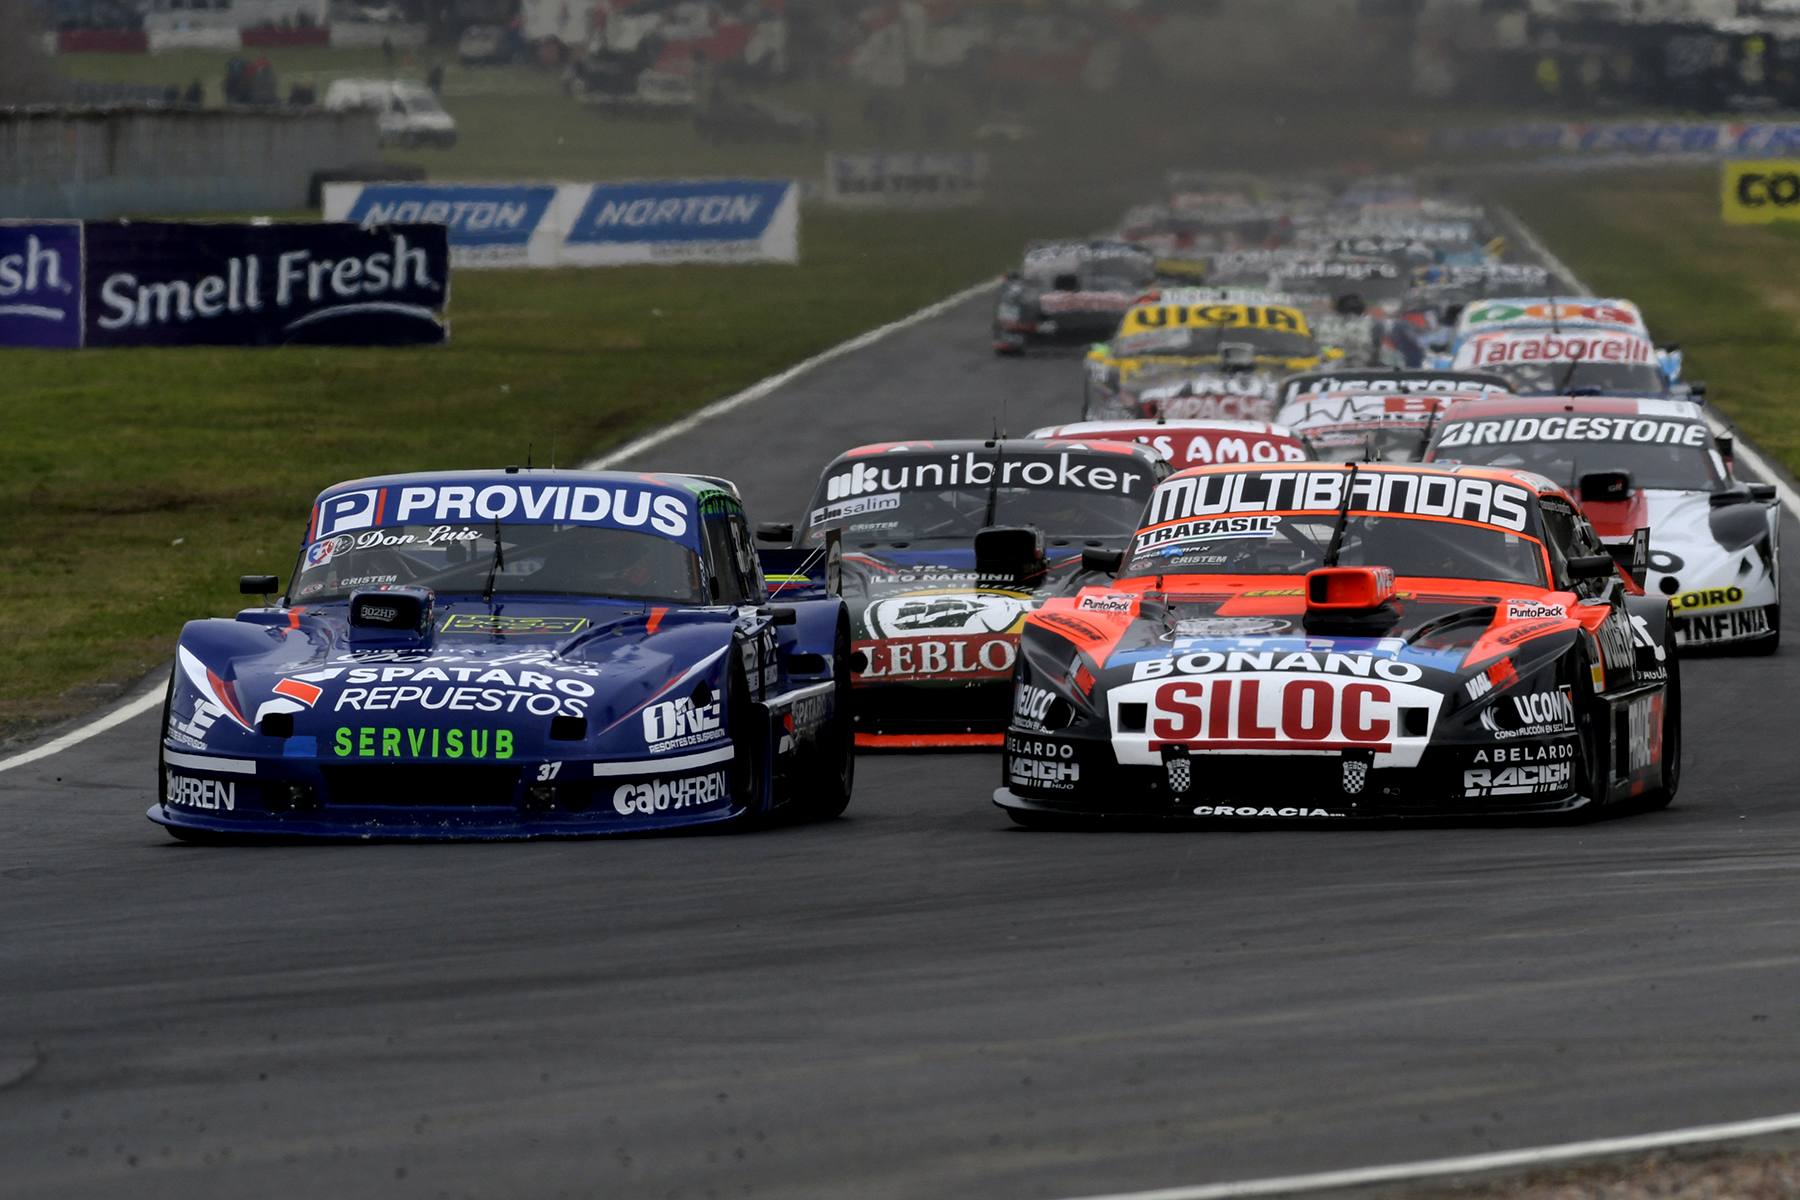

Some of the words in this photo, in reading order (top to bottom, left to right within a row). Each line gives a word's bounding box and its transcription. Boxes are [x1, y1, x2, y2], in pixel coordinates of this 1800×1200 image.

[360, 200, 528, 230] NORTON
[594, 195, 764, 226] NORTON
[98, 255, 261, 330] Smell
[277, 235, 431, 306] Fresh
[1472, 335, 1649, 365] Taraborelli
[1437, 417, 1706, 447] BRIDGESTONE
[880, 453, 1142, 494] unibroker
[397, 485, 688, 536] PROVIDUS
[843, 498, 898, 515] salim
[1148, 472, 1529, 532] MULTIBANDAS
[356, 529, 418, 550] Don
[417, 525, 483, 546] Luis
[1138, 516, 1274, 546] TRABASIL
[1170, 555, 1228, 564] CRISTEM
[341, 575, 398, 586] CRISTEM
[1509, 605, 1563, 618] PuntoPack
[1671, 587, 1743, 609] OIRO
[858, 639, 1017, 678] LEBLO
[1132, 652, 1423, 682] BONANO
[346, 667, 595, 697] SPATARO
[334, 686, 589, 718] REPUESTOS
[1153, 679, 1391, 742] SILOC
[334, 727, 514, 759] SERVISUB
[648, 737, 688, 754] RESORTES
[1007, 738, 1073, 758] ELARDO
[1473, 744, 1573, 763] ABELARDO
[537, 761, 562, 781] 37
[1193, 806, 1329, 817] CROACIA
